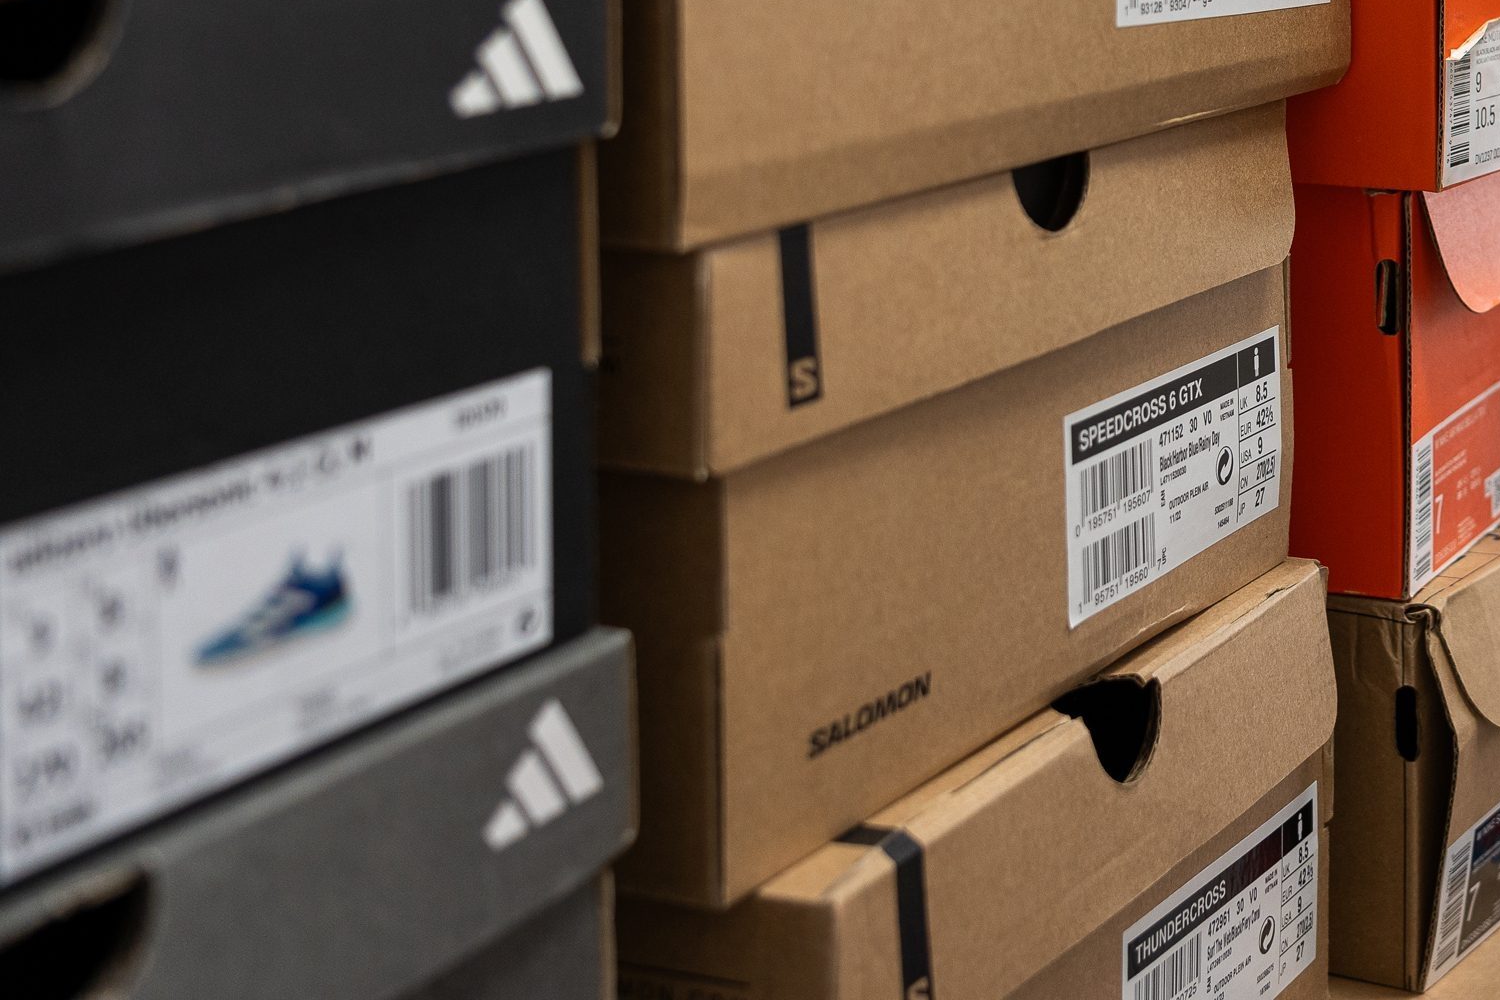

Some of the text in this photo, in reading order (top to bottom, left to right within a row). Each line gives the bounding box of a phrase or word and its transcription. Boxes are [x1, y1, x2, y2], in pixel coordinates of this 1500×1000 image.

[1476, 71, 1482, 93] 9
[1475, 105, 1496, 130] 10.5
[791, 355, 818, 397] S
[1240, 381, 1268, 410] UK 8.5
[1079, 378, 1203, 451] SPEEDCROSS 6 GTX
[1159, 410, 1212, 447] 471152 30 V0
[1240, 422, 1252, 437] EUR
[1212, 430, 1220, 447] Day
[1241, 437, 1263, 464] USA 9
[1240, 475, 1248, 489] CN
[1169, 491, 1189, 510] OUTDOOR
[1190, 486, 1201, 500] PLEIN
[1239, 487, 1265, 516] JP 27
[1075, 490, 1151, 537] 0 195751 195607
[1435, 493, 1444, 535] 7
[1095, 584, 1119, 606] 95751
[1125, 566, 1149, 589] 19560
[1157, 558, 1162, 571] 7
[807, 670, 932, 759] SALOMON
[1282, 841, 1309, 878] UK 8.5
[1282, 886, 1293, 902] EUR
[1135, 879, 1226, 965] THUNDERCROSS
[1208, 907, 1230, 937] 472961
[1237, 898, 1244, 915] 30
[1282, 896, 1302, 927] USA 9
[1281, 938, 1288, 952] CN
[1296, 940, 1305, 962] 27
[1214, 971, 1233, 994] OUTDOOR
[1233, 962, 1245, 978] PLEIN
